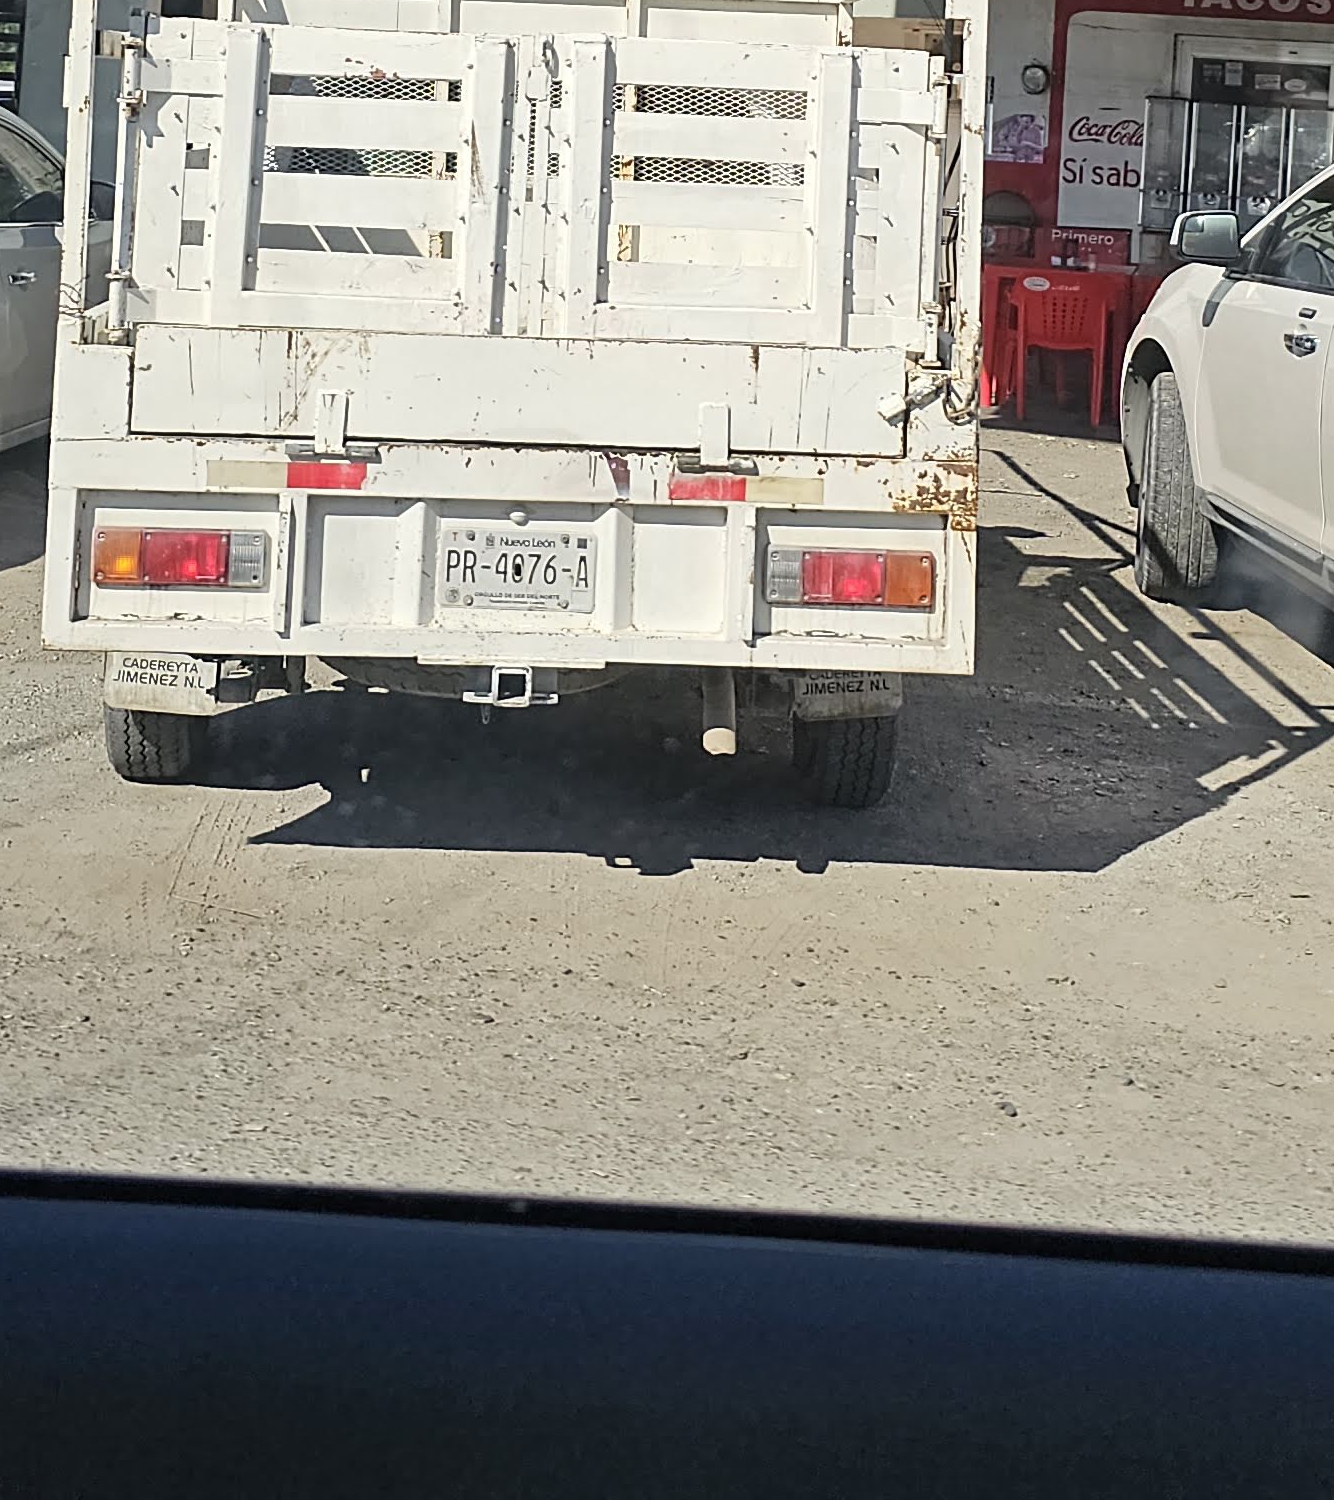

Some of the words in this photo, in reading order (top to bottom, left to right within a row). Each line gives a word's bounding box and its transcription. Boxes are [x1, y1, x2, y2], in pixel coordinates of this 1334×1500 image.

[1062, 158, 1087, 184] Sí
[1052, 229, 1114, 245] Primero
[500, 537, 530, 547] Nuevo
[532, 538, 555, 548] León
[446, 550, 588, 588] PR-4076-A
[123, 658, 198, 673] CADEREYTA
[113, 670, 178, 687] JIMENEZ
[802, 680, 864, 695] JIMENEZ
